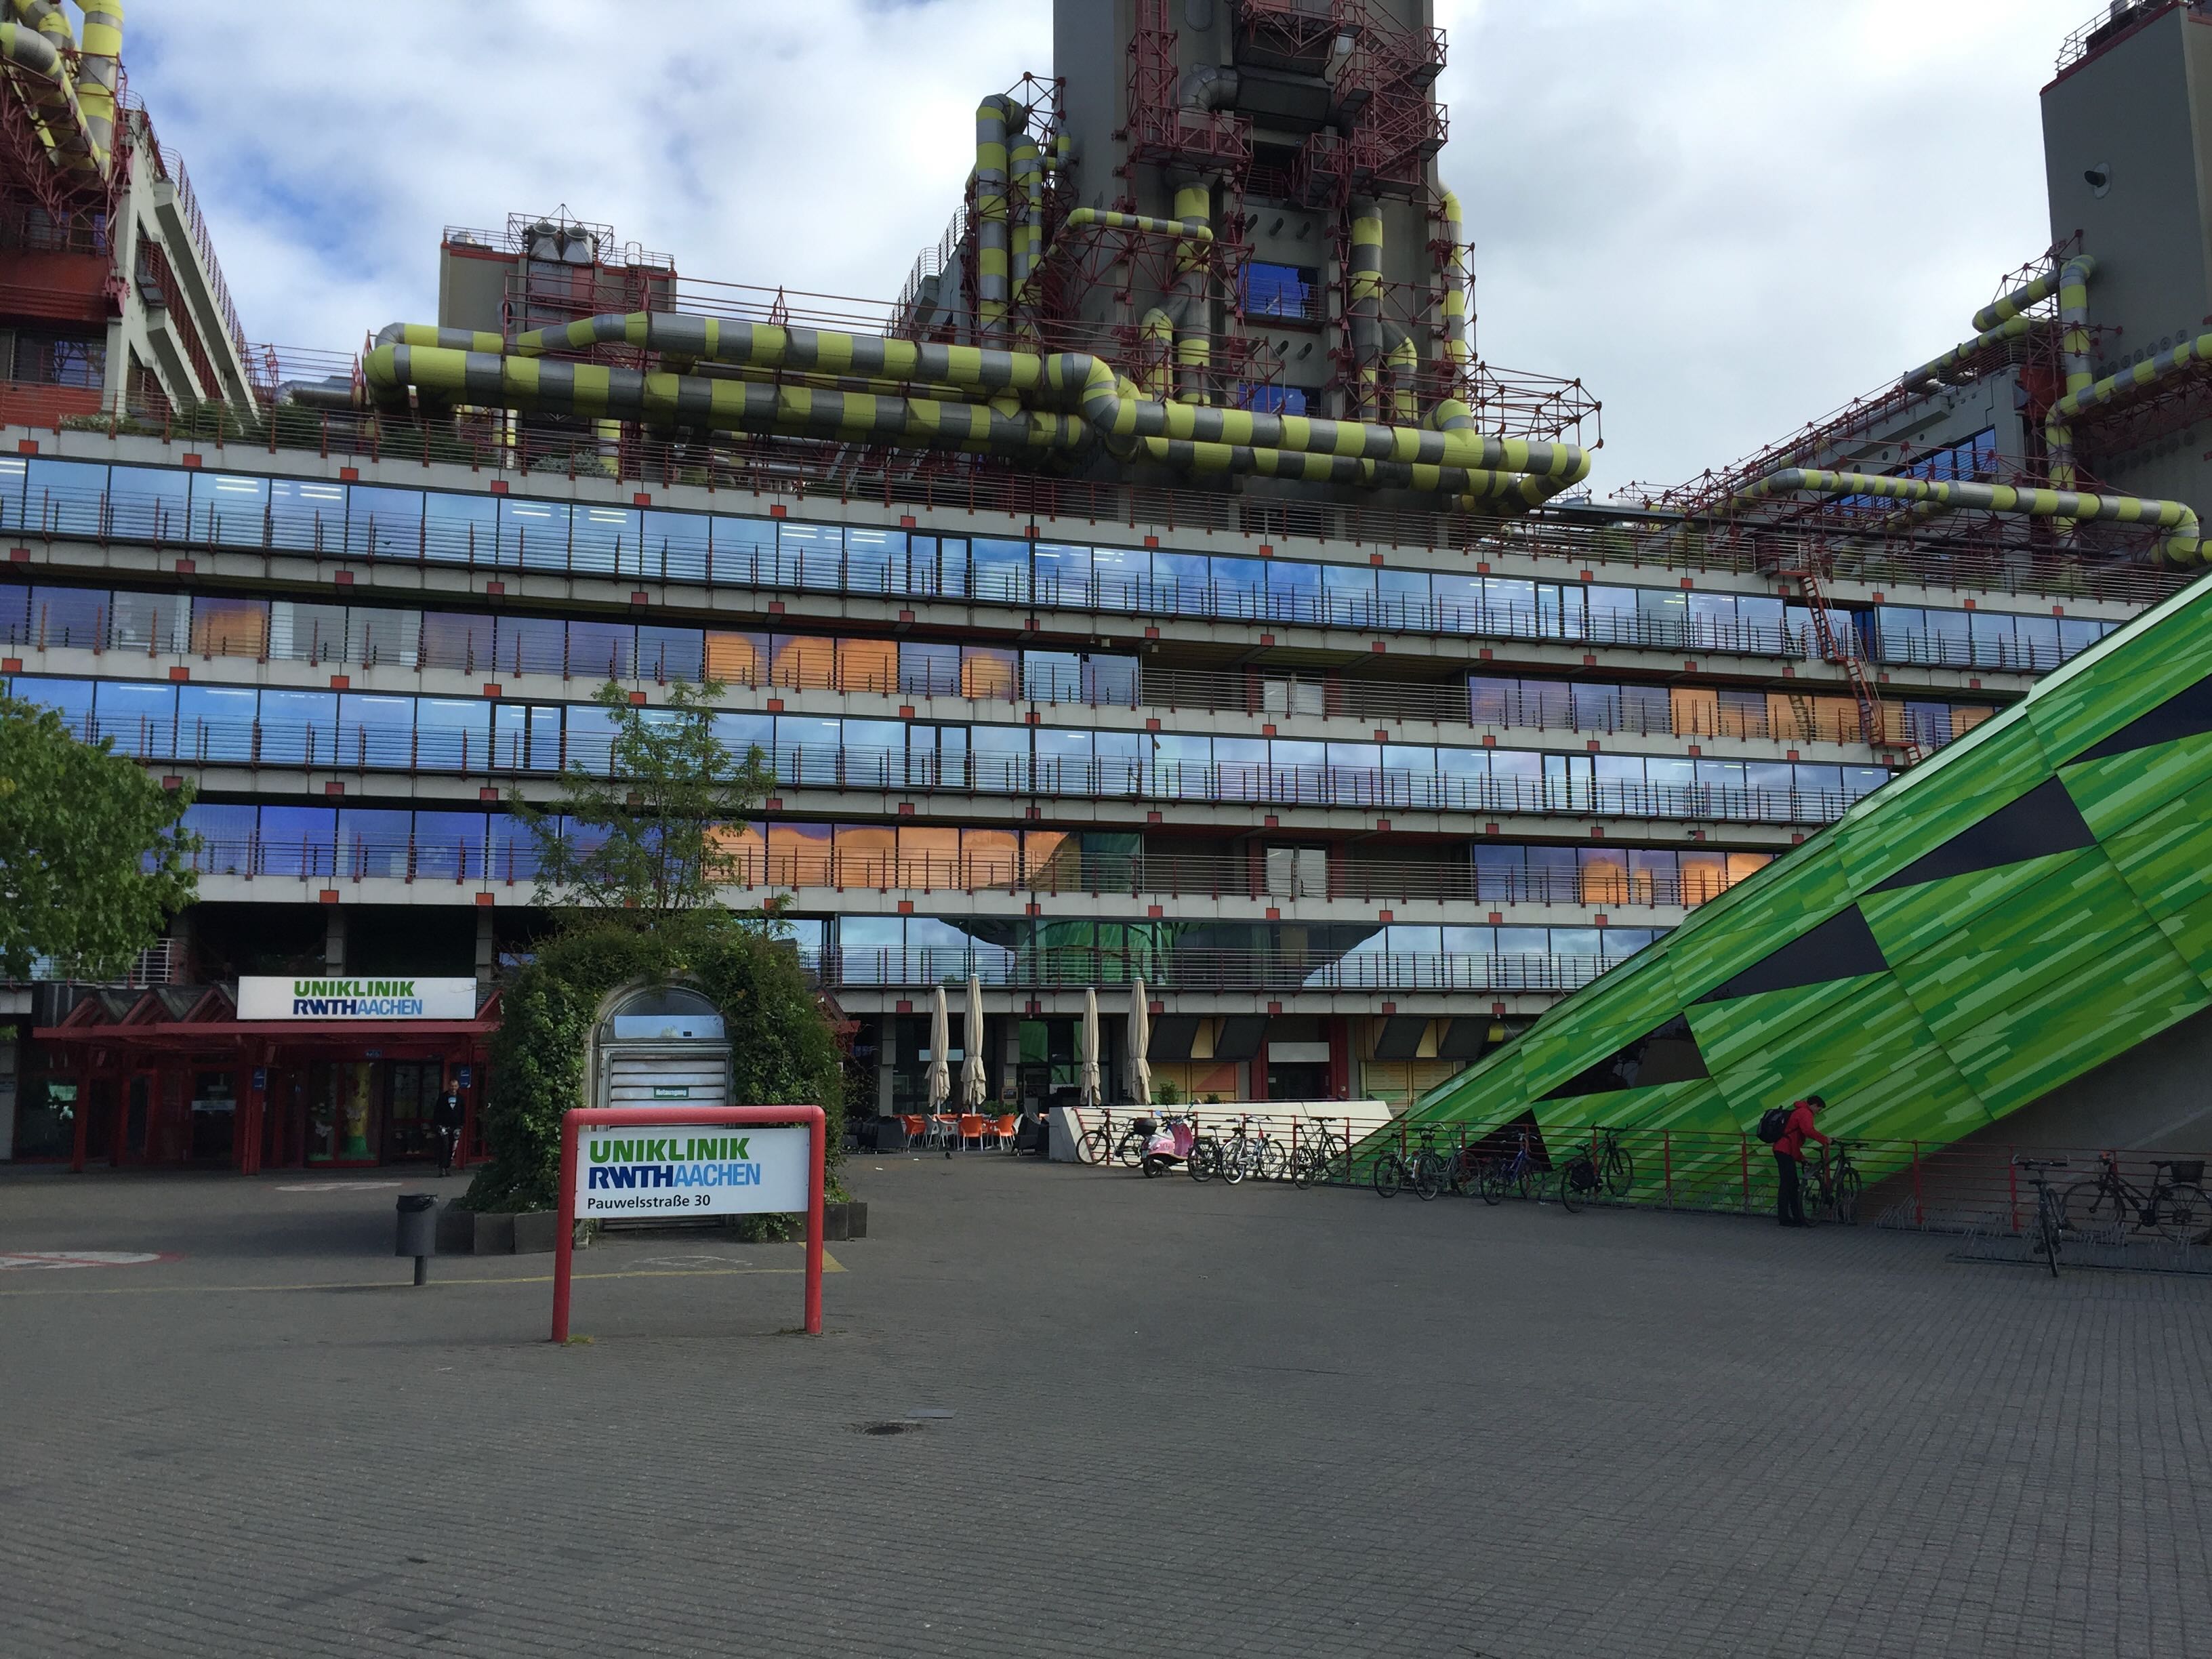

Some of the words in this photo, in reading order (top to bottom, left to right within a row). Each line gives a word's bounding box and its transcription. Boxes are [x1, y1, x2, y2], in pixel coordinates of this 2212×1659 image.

[294, 981, 415, 997] UNIKLINIK
[590, 1137, 750, 1164] UNIKLINIK
[588, 1195, 690, 1210] Pauwelsstraße
[694, 1194, 711, 1206] 30
